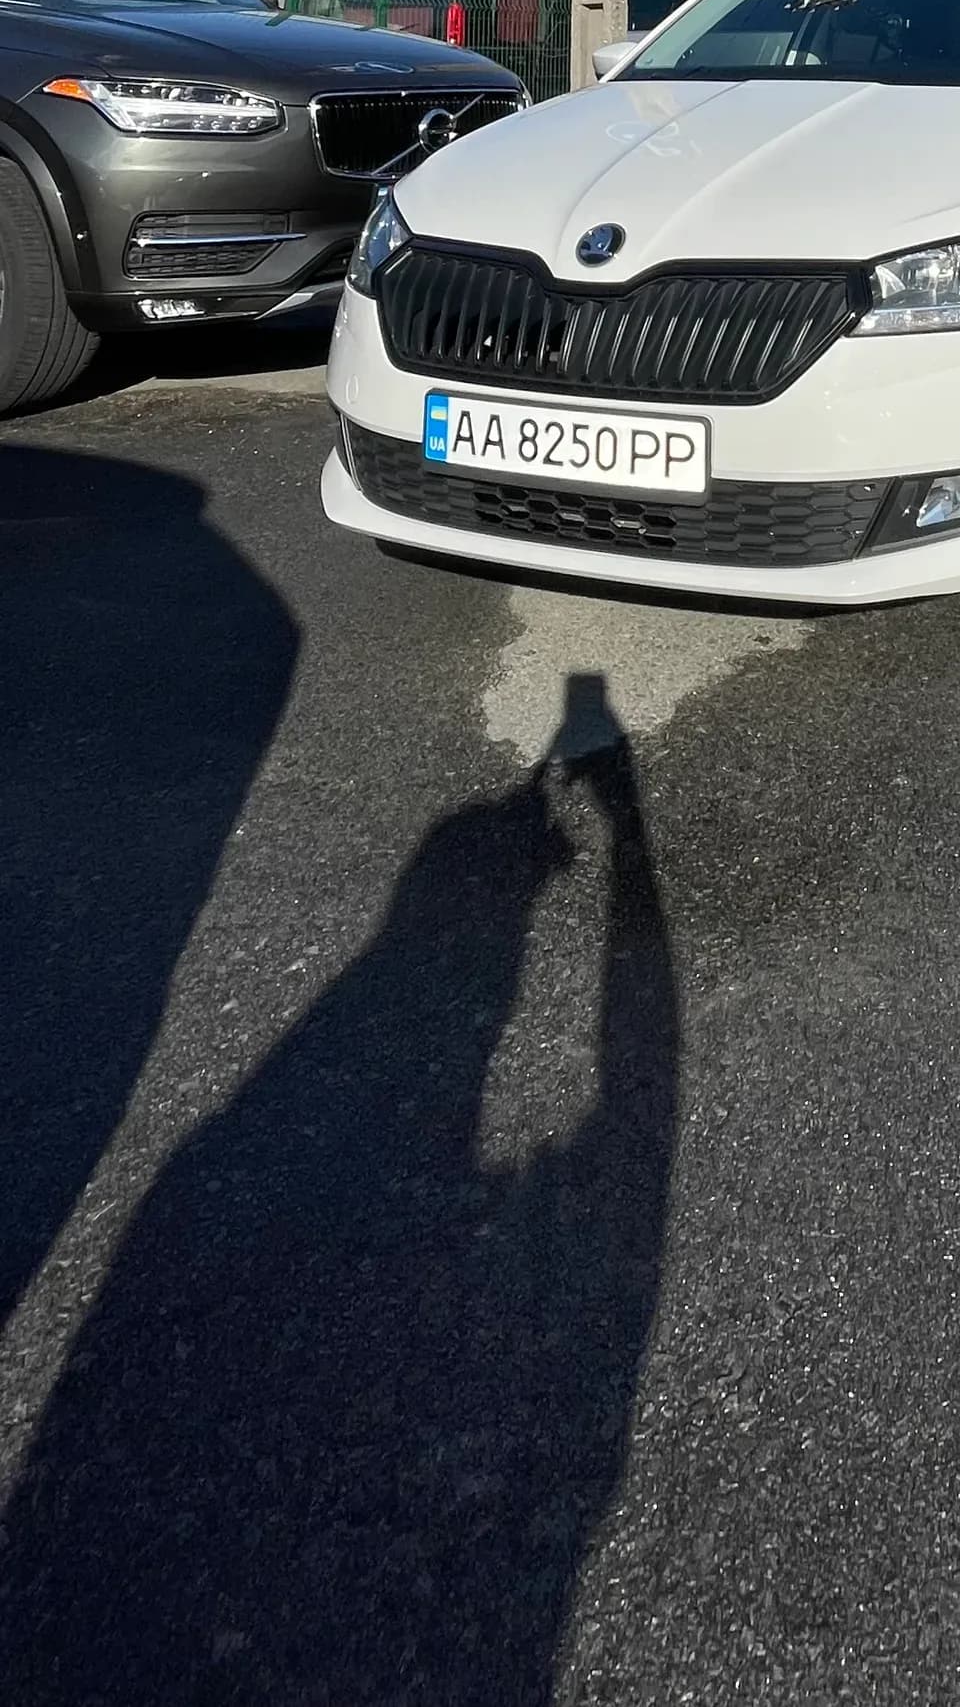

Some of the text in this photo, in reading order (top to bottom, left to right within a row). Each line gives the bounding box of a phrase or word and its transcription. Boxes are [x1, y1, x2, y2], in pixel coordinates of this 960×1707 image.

[430, 436, 446, 452] UA
[452, 410, 695, 478] AA 8250 PP
